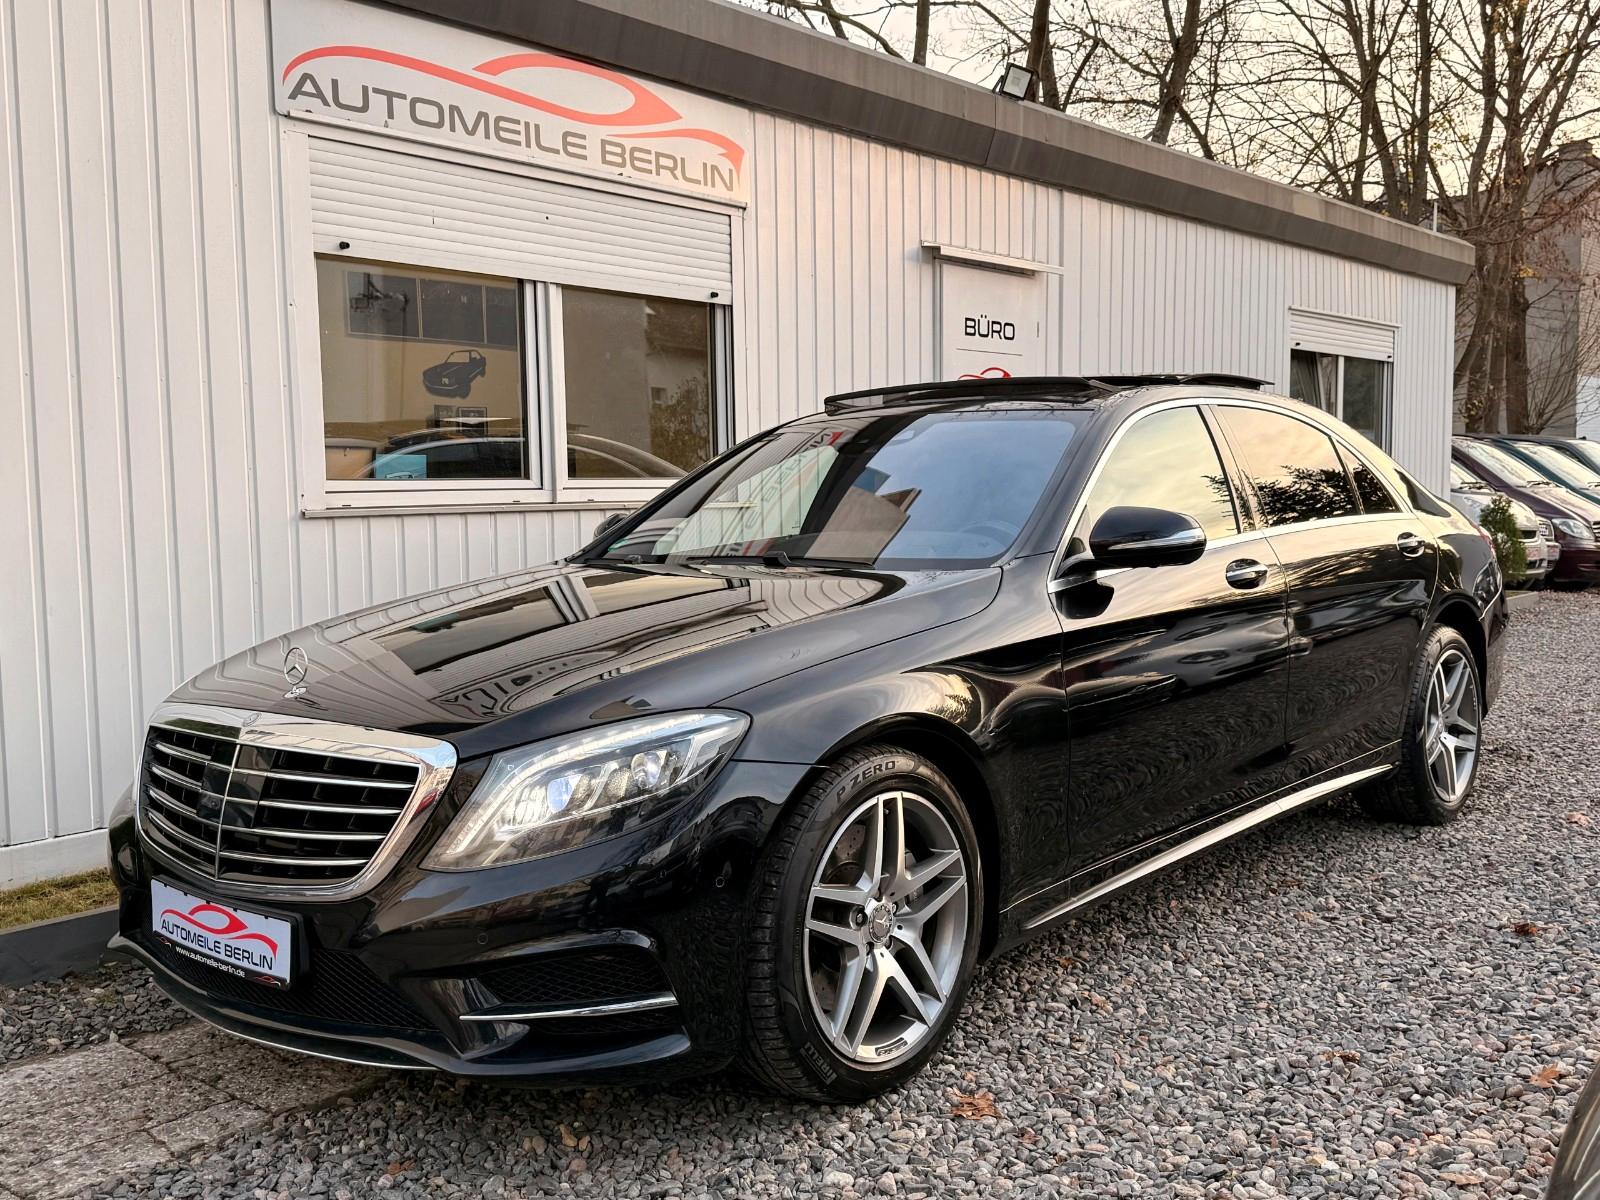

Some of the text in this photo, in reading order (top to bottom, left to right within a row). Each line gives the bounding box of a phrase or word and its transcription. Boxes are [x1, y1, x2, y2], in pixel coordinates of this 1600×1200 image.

[288, 72, 734, 191] AUTOMEILE BERLIN
[965, 314, 1015, 341] BÜRO
[837, 760, 896, 804] P ZERO
[160, 919, 273, 971] AUTOMEILE BERLIN
[175, 946, 246, 978] www.automeile-berlin.de
